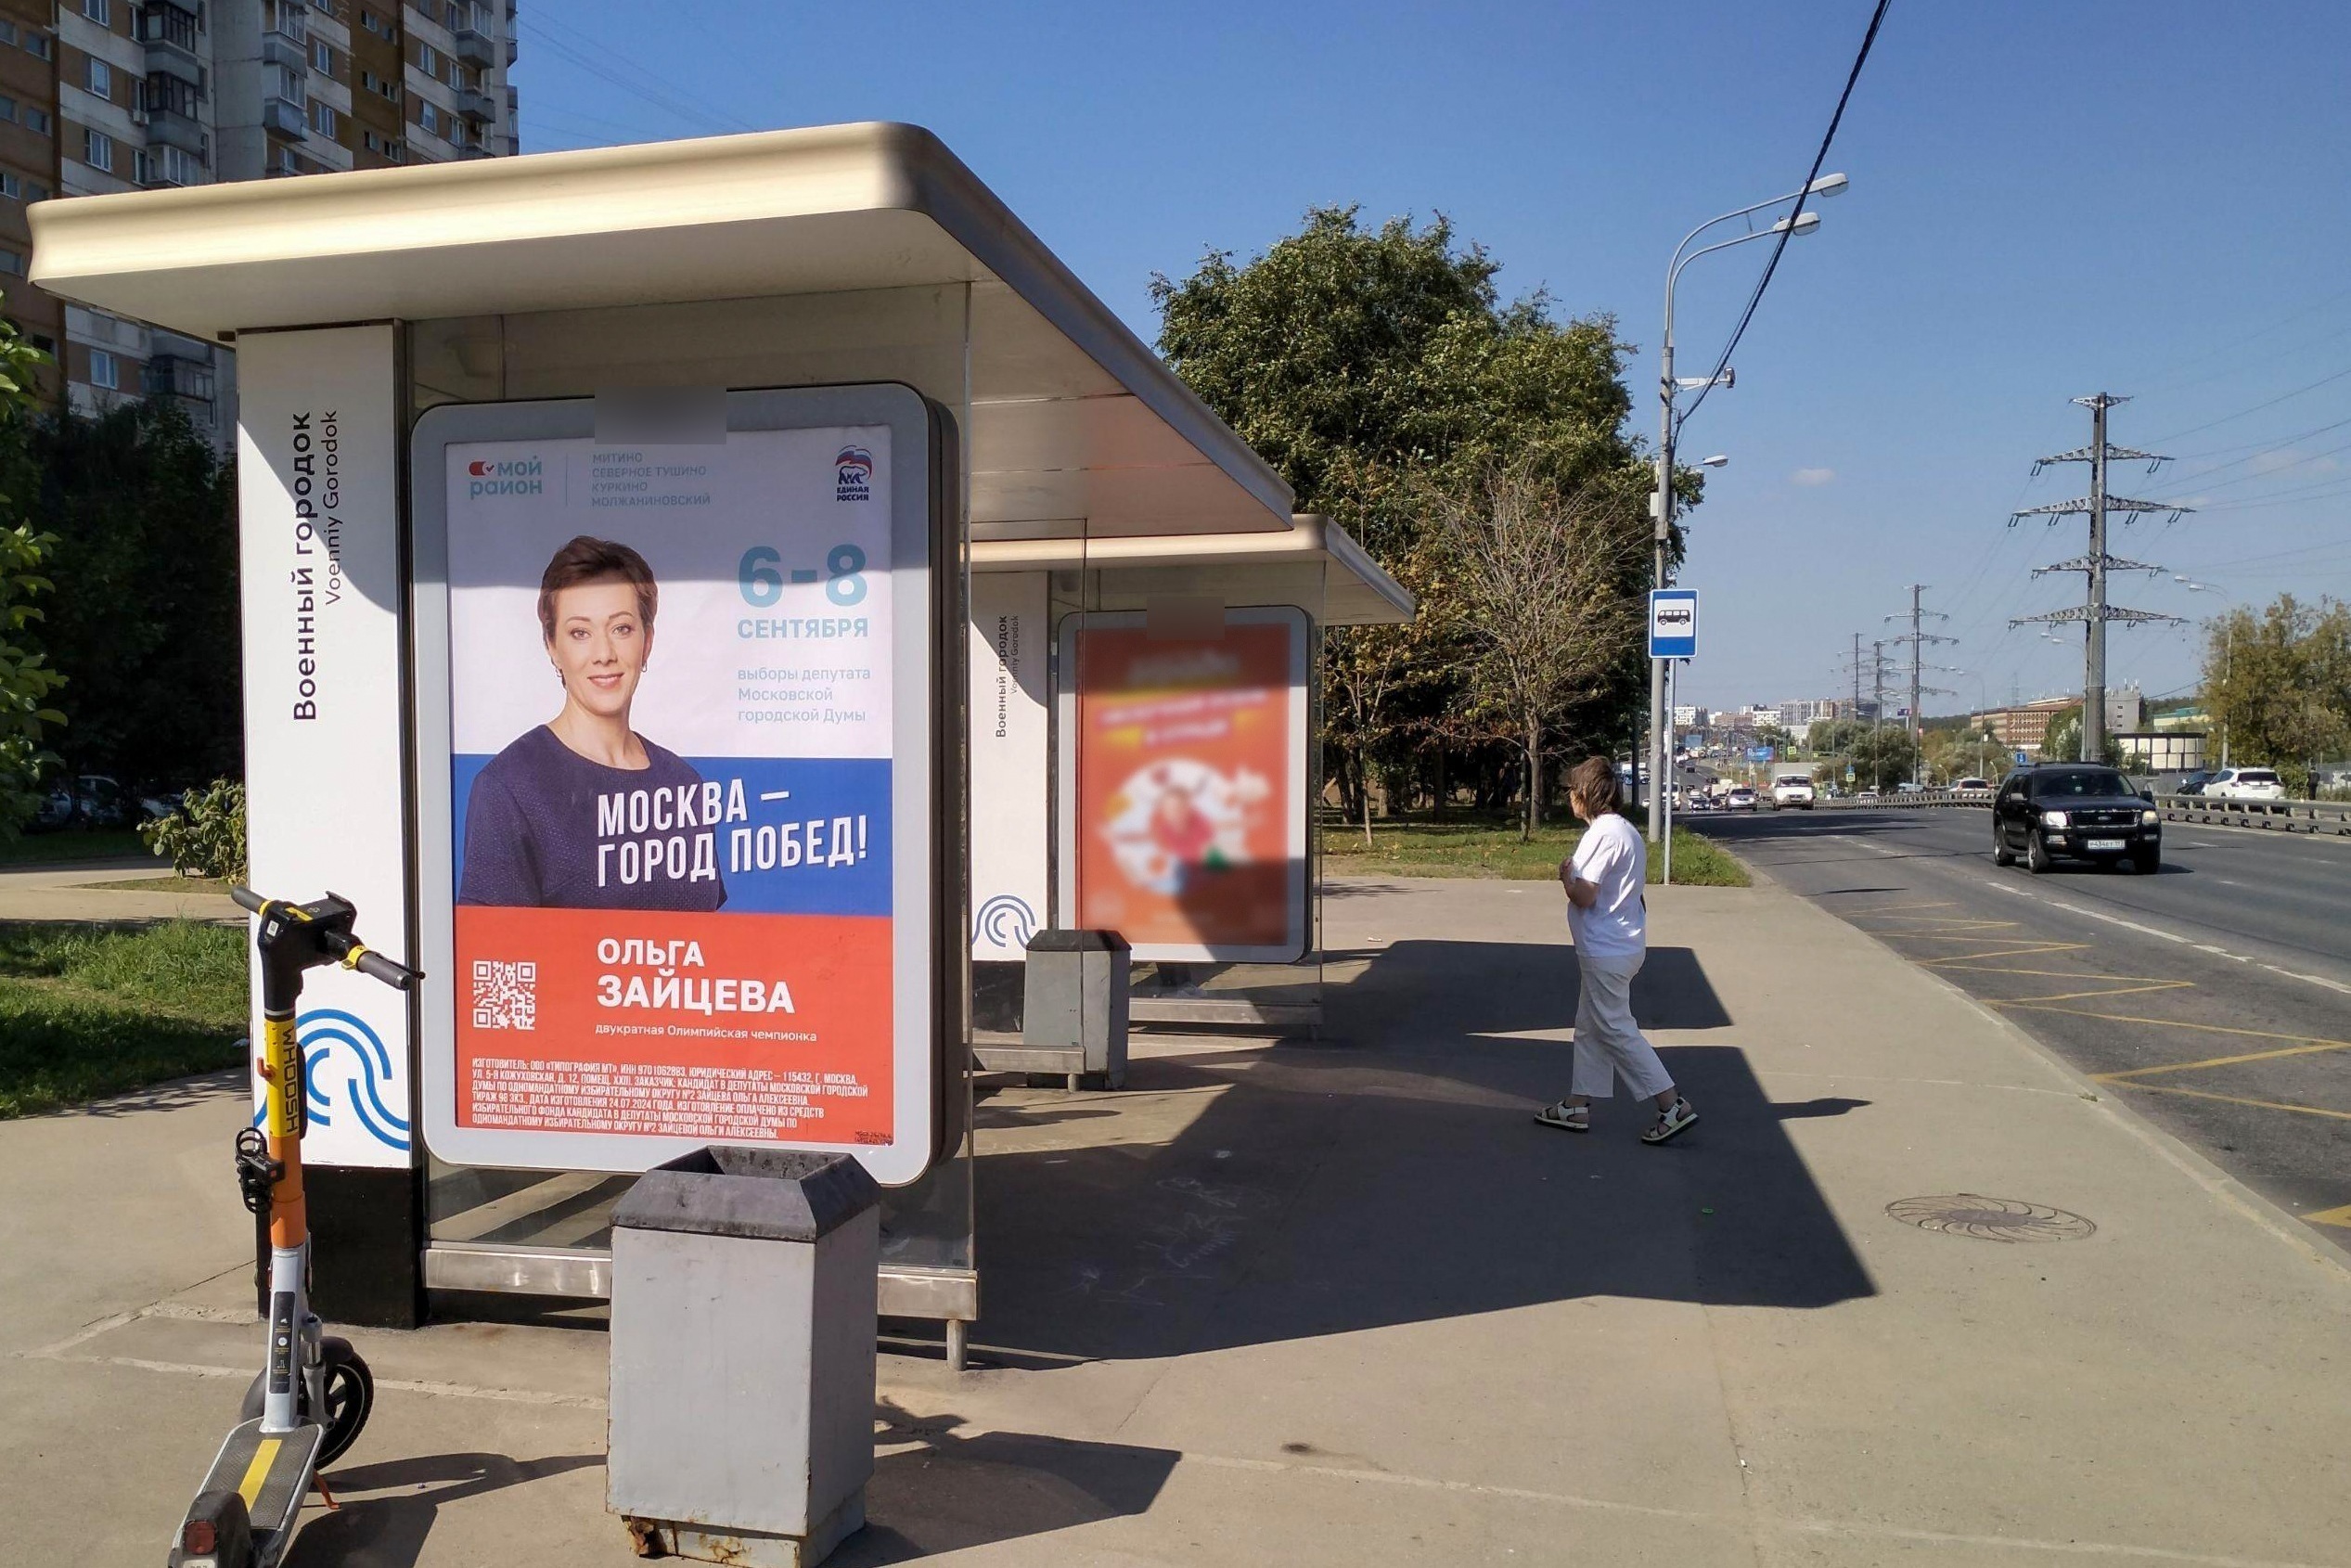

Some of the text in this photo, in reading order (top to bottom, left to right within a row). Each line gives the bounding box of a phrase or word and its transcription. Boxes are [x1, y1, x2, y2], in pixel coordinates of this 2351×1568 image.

[497, 456, 542, 476] мой
[592, 453, 642, 463] МИТИНО
[592, 466, 706, 478] СЕВЕРНОЕ ТУШИНО
[592, 482, 648, 493] КУРКИНО
[321, 409, 343, 605] Voenniy Gorodok
[592, 493, 711, 508] МОЛЖАНИНОВСКИЙ
[291, 411, 318, 720] Военный городок
[738, 618, 868, 638] СЕНТЯБРЯ
[738, 667, 870, 683] выборы депутата
[996, 615, 1008, 738] Военный городок
[738, 688, 833, 701] Московской
[738, 708, 866, 725] городской Думы
[597, 778, 749, 837] МОСКВА
[597, 815, 868, 888] ГОРОД ПОБЕД!
[597, 939, 705, 968] ОЛЬГА
[597, 969, 795, 1016] ЗАЙЦЕВА
[595, 1023, 817, 1043] двукратная Олимпийская чемпионка
[282, 1025, 299, 1133] WHOOSH
[472, 1058, 530, 1070] ИЗГОТОВИТЕЛЬ:
[546, 1060, 600, 1073] «ТИПОГРАФИЯ
[621, 1064, 636, 1074] ИНН
[689, 1066, 746, 1080] ЮРИДИЧЕСКИЙ
[748, 1069, 773, 1081] АДРЕС
[824, 1073, 858, 1085] МОСКВА,
[472, 1080, 495, 1092] ДУМЫ
[497, 1082, 507, 1092] ПО
[508, 1082, 579, 1096] ОДНОМАНДАТНОМУ
[581, 1086, 650, 1099] ИЗБИРАТЕЛЬНОМУ
[652, 1088, 681, 1100] ОКРУГУ
[697, 1089, 731, 1103] ЗАЙЦЕВА
[733, 1092, 757, 1103] ОЛЬГА
[677, 1078, 719, 1090] КАНДИДАТ
[720, 1080, 726, 1090] В
[727, 1080, 768, 1093] ДЕПУТАТЫ
[769, 1081, 821, 1095] МОСКОВСКОЙ
[822, 1084, 868, 1098] ГОРОДСКОЙ
[472, 1091, 497, 1102] ТИРАЖ
[530, 1094, 548, 1106] ДАТА
[550, 1095, 607, 1108] ИЗГОТОВЛЕНИЯ
[677, 1100, 735, 1113] ИЗГОТОВЛЕНИЕ
[737, 1103, 777, 1115] ОПЛАЧЕНО
[777, 1105, 788, 1116] ИЗ
[790, 1106, 825, 1118] СРЕДСТВ
[472, 1102, 797, 1128] ИЗБИРАТЕЛЬНОГО ФОНДА КАНДИДАТА В ДЕПУТАТЫ МОСКОВСКОЙ ГОРОДСКОЙ ДУМЫ ПО
[472, 1113, 543, 1127] ОДНОМАНДАТНОМУ
[545, 1117, 612, 1130] ИЗБИРАТЕЛЬНОМУ
[614, 1120, 642, 1132] ОКРУГУ
[658, 1122, 698, 1135] ЗАЙЦЕВОЙ
[700, 1125, 724, 1136] ОЛЬГИ
